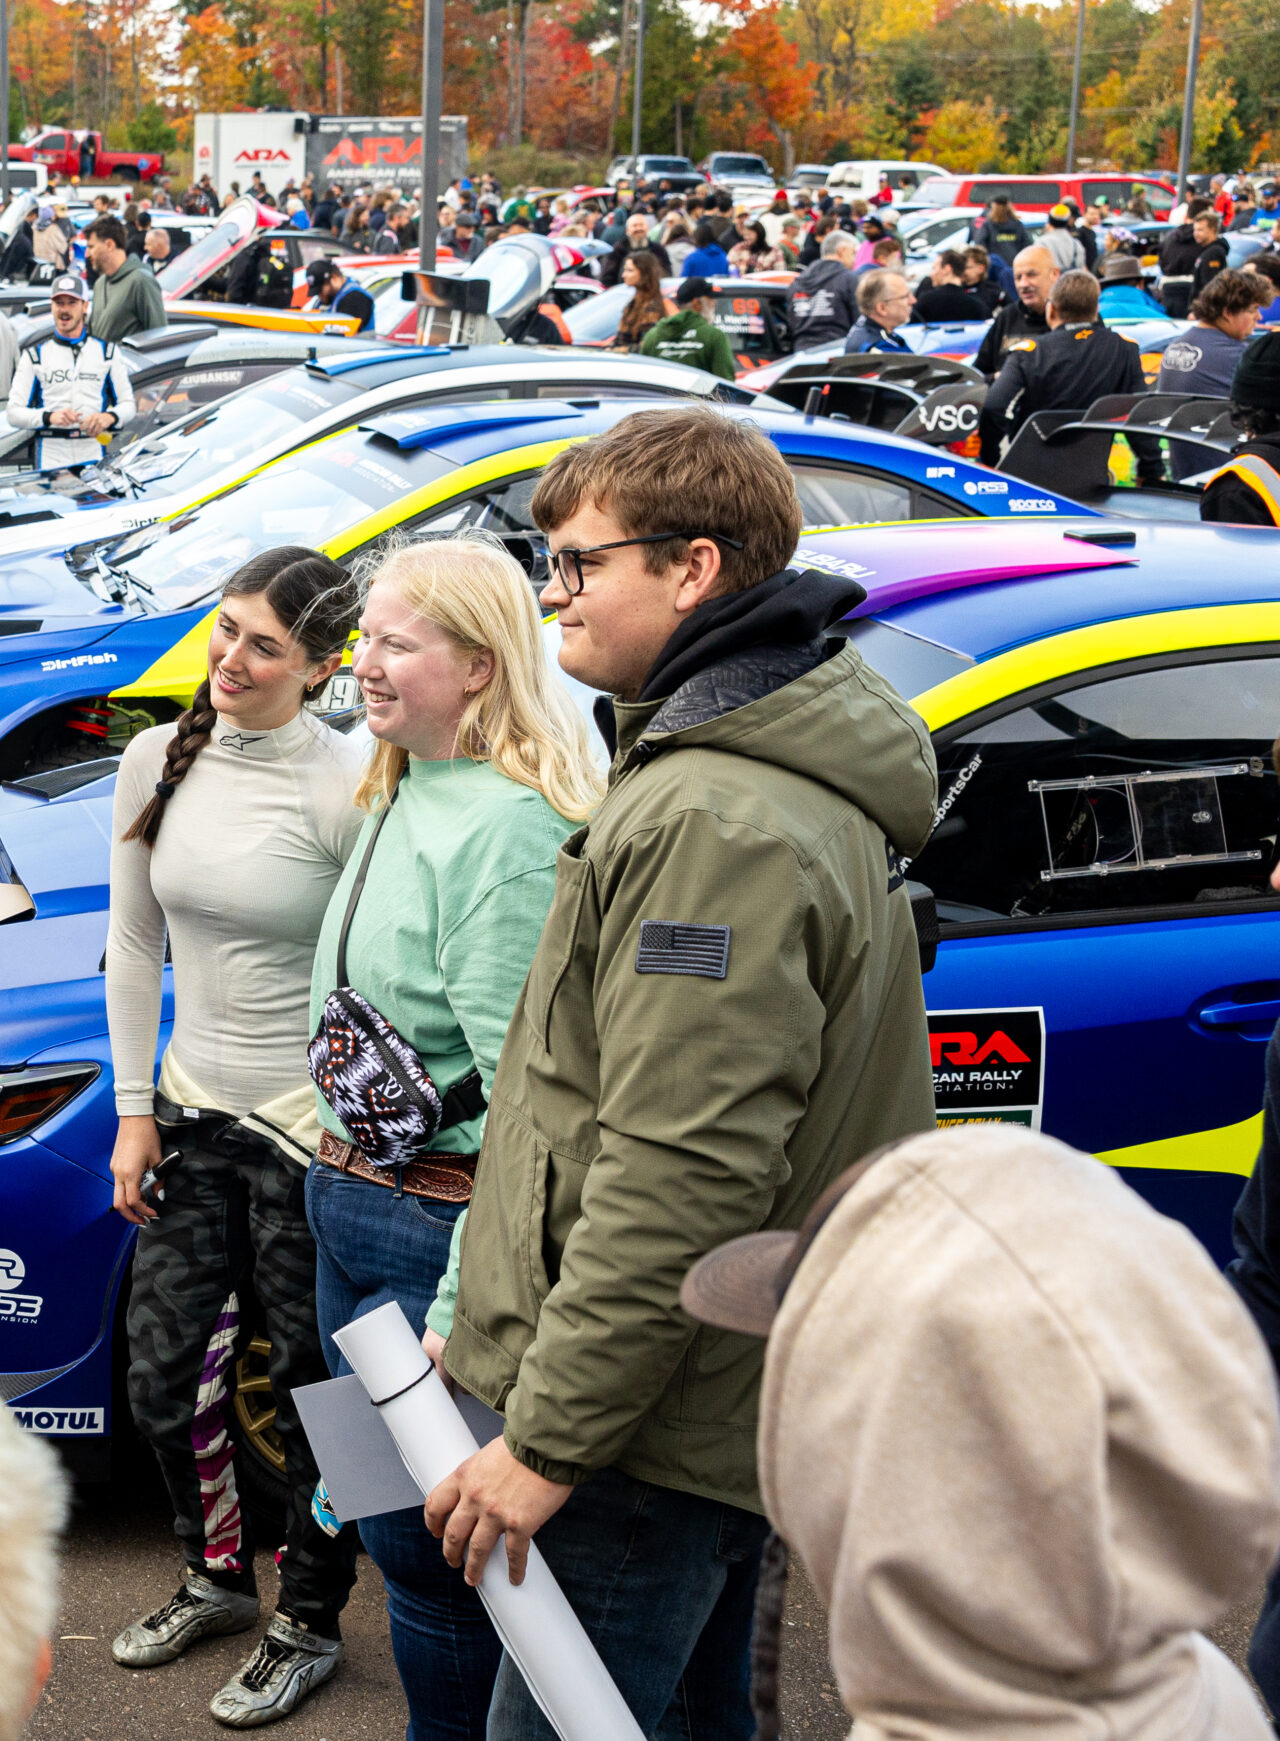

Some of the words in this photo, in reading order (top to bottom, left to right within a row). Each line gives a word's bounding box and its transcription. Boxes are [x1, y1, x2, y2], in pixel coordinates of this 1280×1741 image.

[234, 149, 291, 162] ARA
[733, 298, 760, 315] 69
[41, 652, 118, 672] DirtFish
[929, 1030, 1031, 1067] RA
[969, 1070, 1022, 1081] RALLY
[934, 1082, 1007, 1093] CIATION
[13, 1411, 99, 1430] MOTUL
